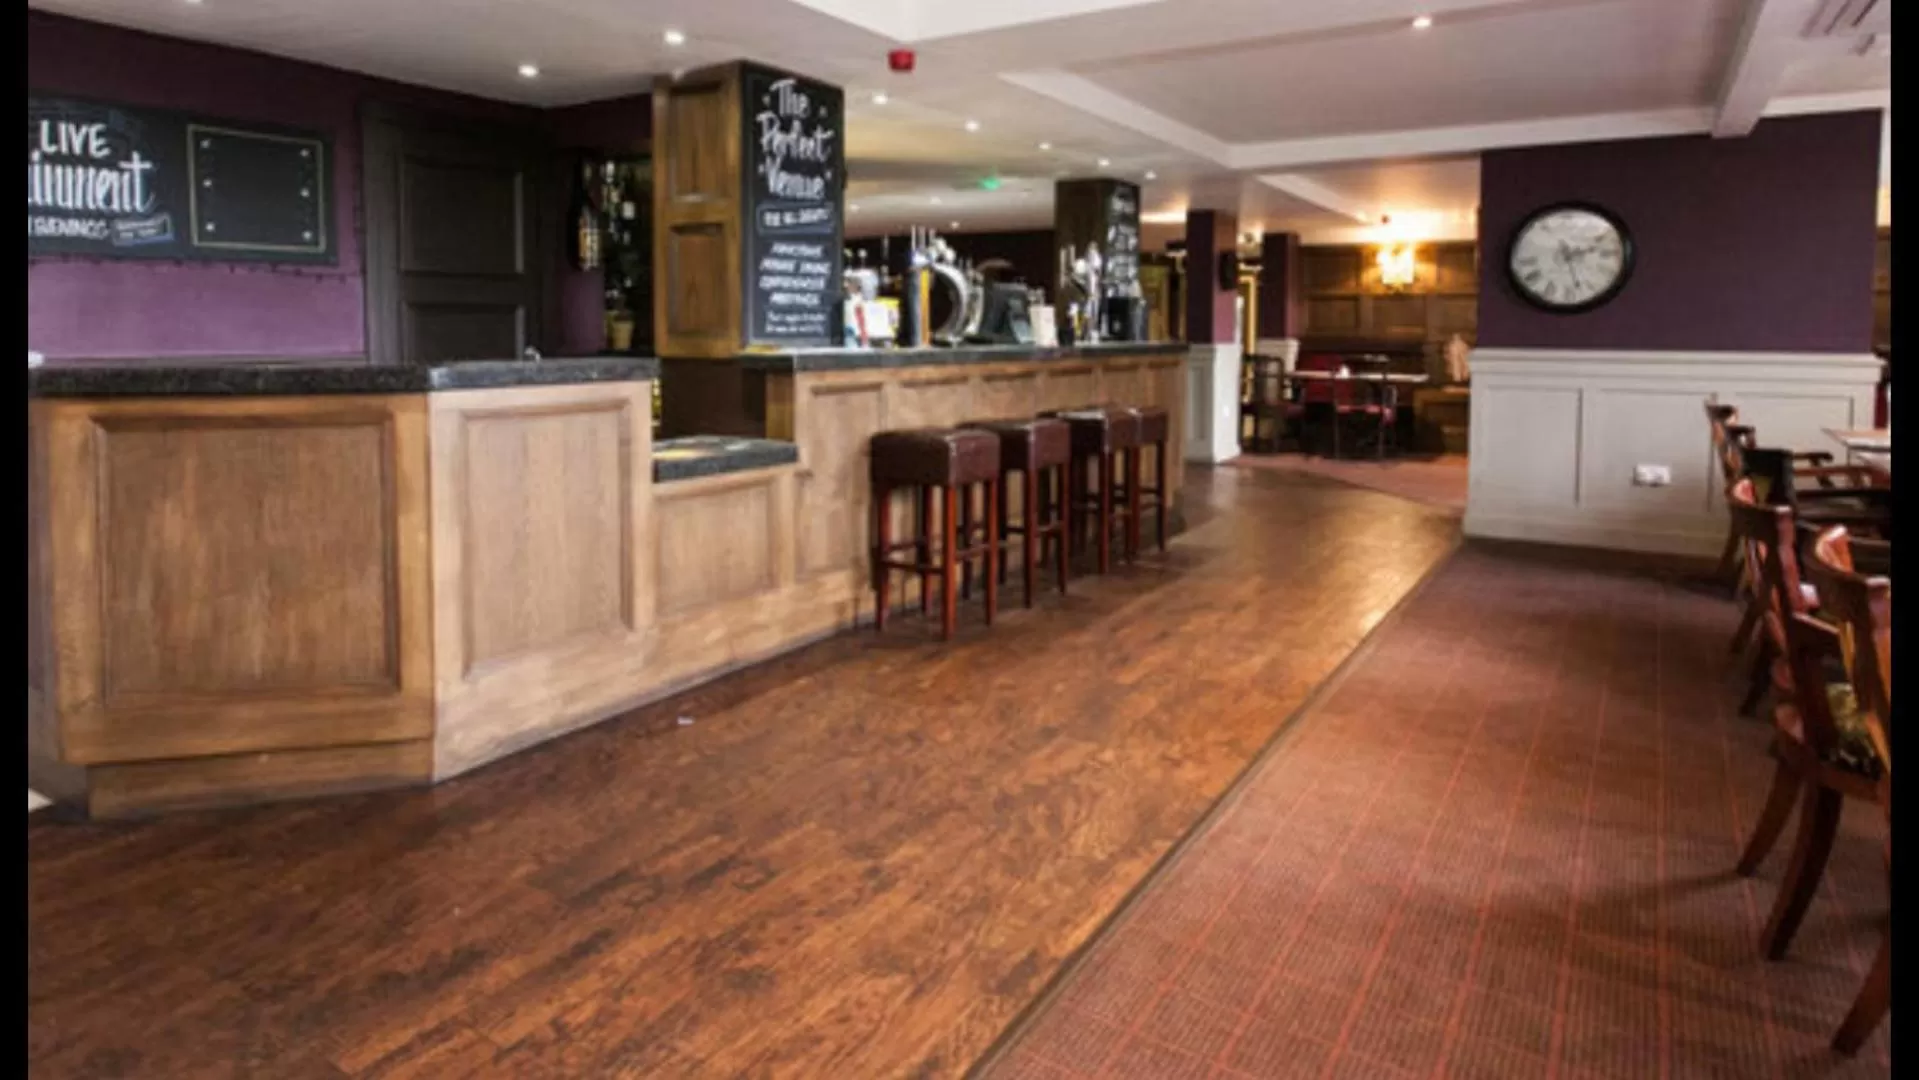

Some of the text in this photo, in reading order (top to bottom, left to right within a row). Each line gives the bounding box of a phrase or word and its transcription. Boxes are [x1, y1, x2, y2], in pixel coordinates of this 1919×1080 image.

[769, 79, 809, 118] The
[40, 119, 110, 159] LIVE
[756, 110, 834, 162] Perfect
[765, 156, 825, 199] Venue
